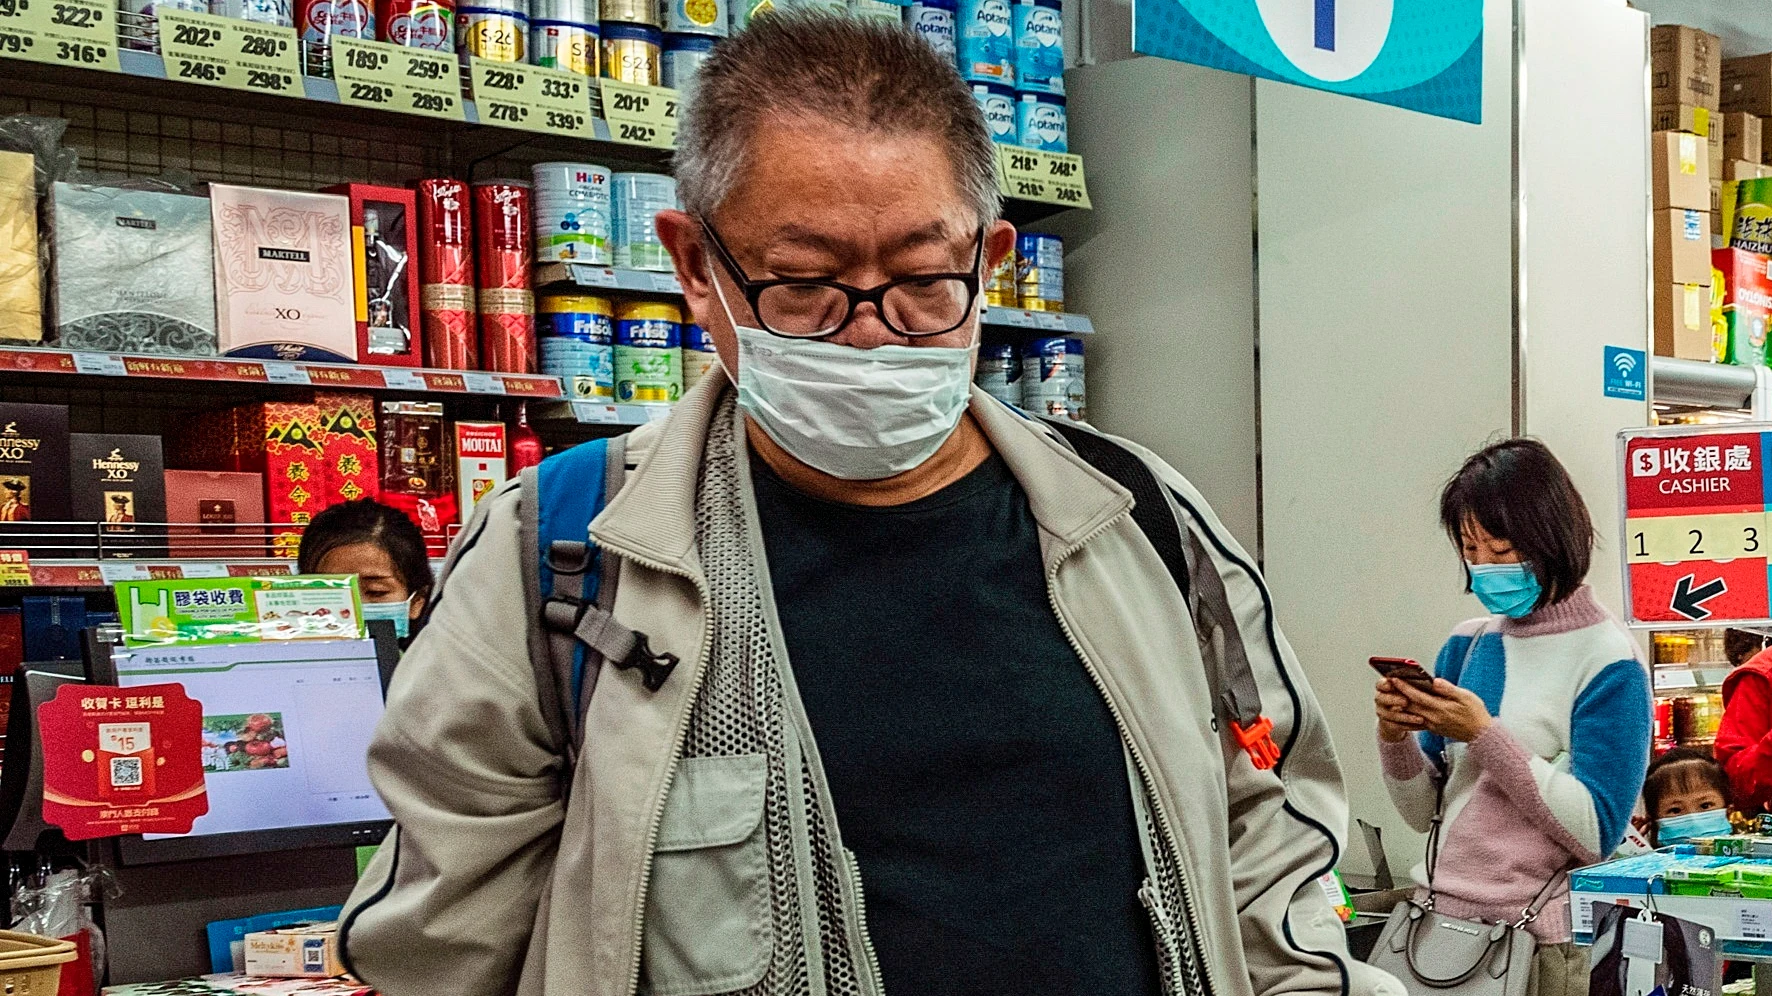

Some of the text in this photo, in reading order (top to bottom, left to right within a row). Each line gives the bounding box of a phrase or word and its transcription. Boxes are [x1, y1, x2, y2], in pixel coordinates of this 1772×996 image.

[262, 249, 307, 261] MARTELL
[274, 307, 301, 321] XO
[0, 436, 41, 450] nnessy
[461, 438, 502, 453] MOUTAI
[92, 458, 140, 472] Hennessy
[1664, 445, 1752, 474] 收銀處
[107, 468, 127, 479] XO
[1659, 477, 1731, 494] CASHIER
[1634, 532, 1649, 557] 1
[1688, 529, 1705, 554] 2
[1743, 527, 1759, 552] 3
[174, 589, 244, 606] 膠袋收費
[117, 737, 135, 751] 15
